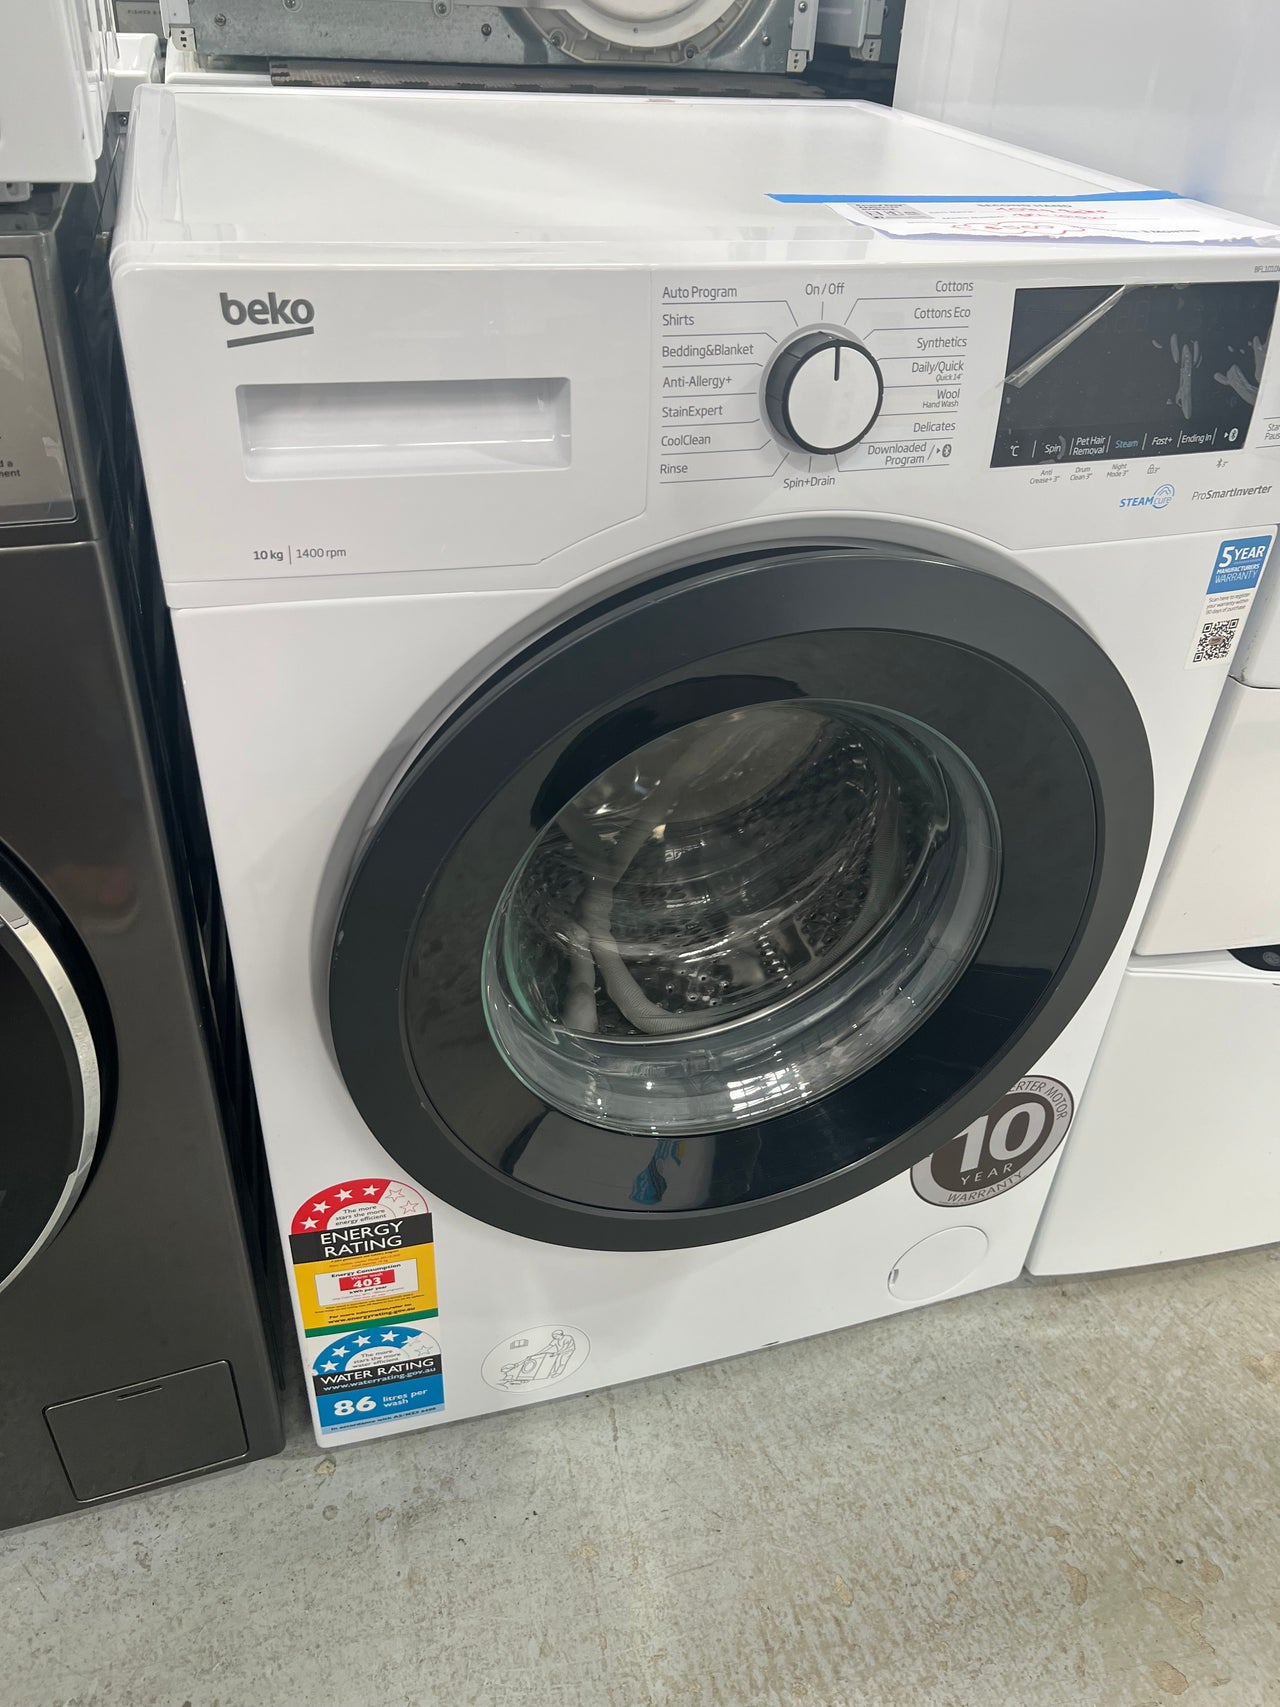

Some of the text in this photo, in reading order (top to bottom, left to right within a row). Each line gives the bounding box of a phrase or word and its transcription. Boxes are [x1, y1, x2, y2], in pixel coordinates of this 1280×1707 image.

[662, 285, 737, 300] Auto Program
[805, 283, 820, 295] On
[828, 283, 845, 295] Off
[935, 280, 974, 292] Cottons
[219, 292, 315, 325] beko
[914, 306, 971, 319] Cottons Eco
[662, 314, 695, 326] Shirts
[917, 336, 967, 351] Synthetics
[662, 344, 754, 359] Bedding&Blanket
[912, 360, 964, 375] Daily/Quick
[662, 376, 733, 390] Anti-Allergy+
[936, 374, 952, 382] Quick
[937, 388, 961, 400] Wool
[941, 400, 959, 408] Wash
[662, 405, 723, 418] StainExpert
[913, 421, 956, 433] Delicates
[661, 435, 711, 447] CoolClean
[1076, 435, 1106, 446] Pet Hair
[1115, 440, 1138, 449] Steam
[1152, 436, 1173, 447] Fast+
[1181, 433, 1212, 446] Ending In
[867, 442, 927, 455] Downloaded
[1044, 444, 1061, 455] Spin
[1072, 445, 1105, 456] Removal
[885, 455, 925, 467] Program
[1112, 463, 1127, 471] Night
[660, 463, 688, 474] Rinse
[783, 476, 836, 490] Spin+Drain
[1192, 485, 1272, 501] ProSmartInverter
[253, 548, 346, 561] 10 kg 1400 rpm
[1219, 546, 1266, 568] 5 YEAR
[1215, 570, 1258, 583] WARRANTY
[1045, 1086, 1068, 1120] MOTOR
[952, 1102, 1046, 1173] 10
[961, 1162, 1013, 1186] YEAR
[947, 1171, 1023, 1202] WARRANTY
[360, 1213, 387, 1222] efficient
[320, 1220, 403, 1245] ENERGY
[324, 1236, 402, 1258] RATING
[356, 1263, 401, 1274] Consumption
[353, 1277, 382, 1288] 403
[372, 1357, 399, 1366] efficient
[320, 1358, 434, 1384] WATER RATING
[323, 1367, 436, 1391] www.waterrating.gov.au
[383, 1388, 428, 1402] litres per
[334, 1396, 377, 1416] 86
[383, 1399, 409, 1408] wash
